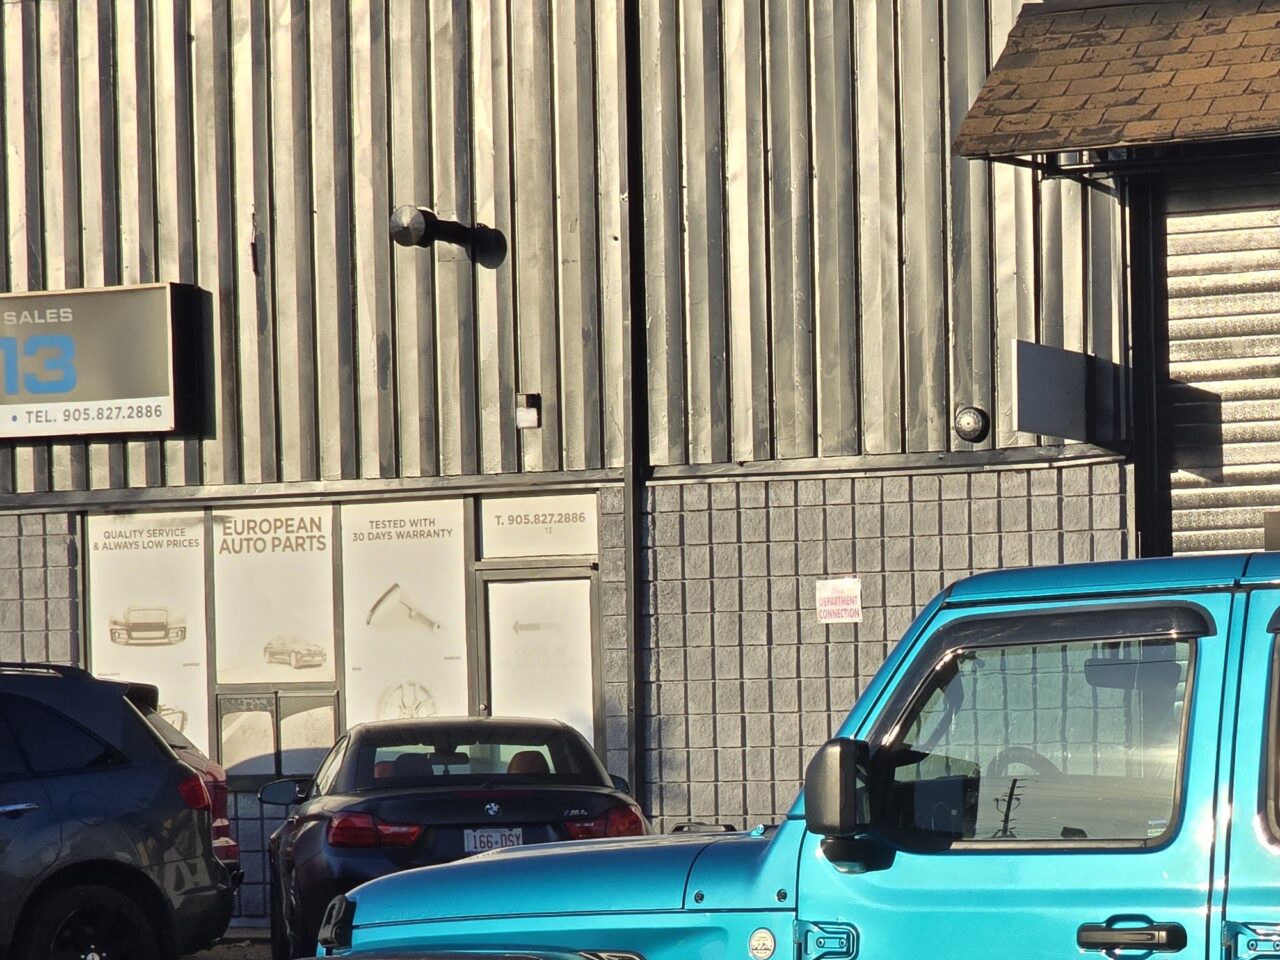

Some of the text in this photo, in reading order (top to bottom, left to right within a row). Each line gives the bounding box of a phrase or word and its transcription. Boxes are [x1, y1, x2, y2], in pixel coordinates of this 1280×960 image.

[3, 308, 73, 325] SALES
[26, 405, 162, 423] TEL. 905.827.2886
[369, 518, 436, 530] TESTED WITH
[494, 512, 586, 525] T. 905.827.2886
[222, 516, 322, 536] EUROPEAN
[103, 528, 187, 540] QUALITY SERVICE
[352, 529, 453, 542] 30 DAYS WARRANTY
[93, 538, 200, 551] & ALWAYS LOW PRICES
[219, 535, 327, 555] AUTO PARTS
[819, 607, 860, 619] CONNECTION
